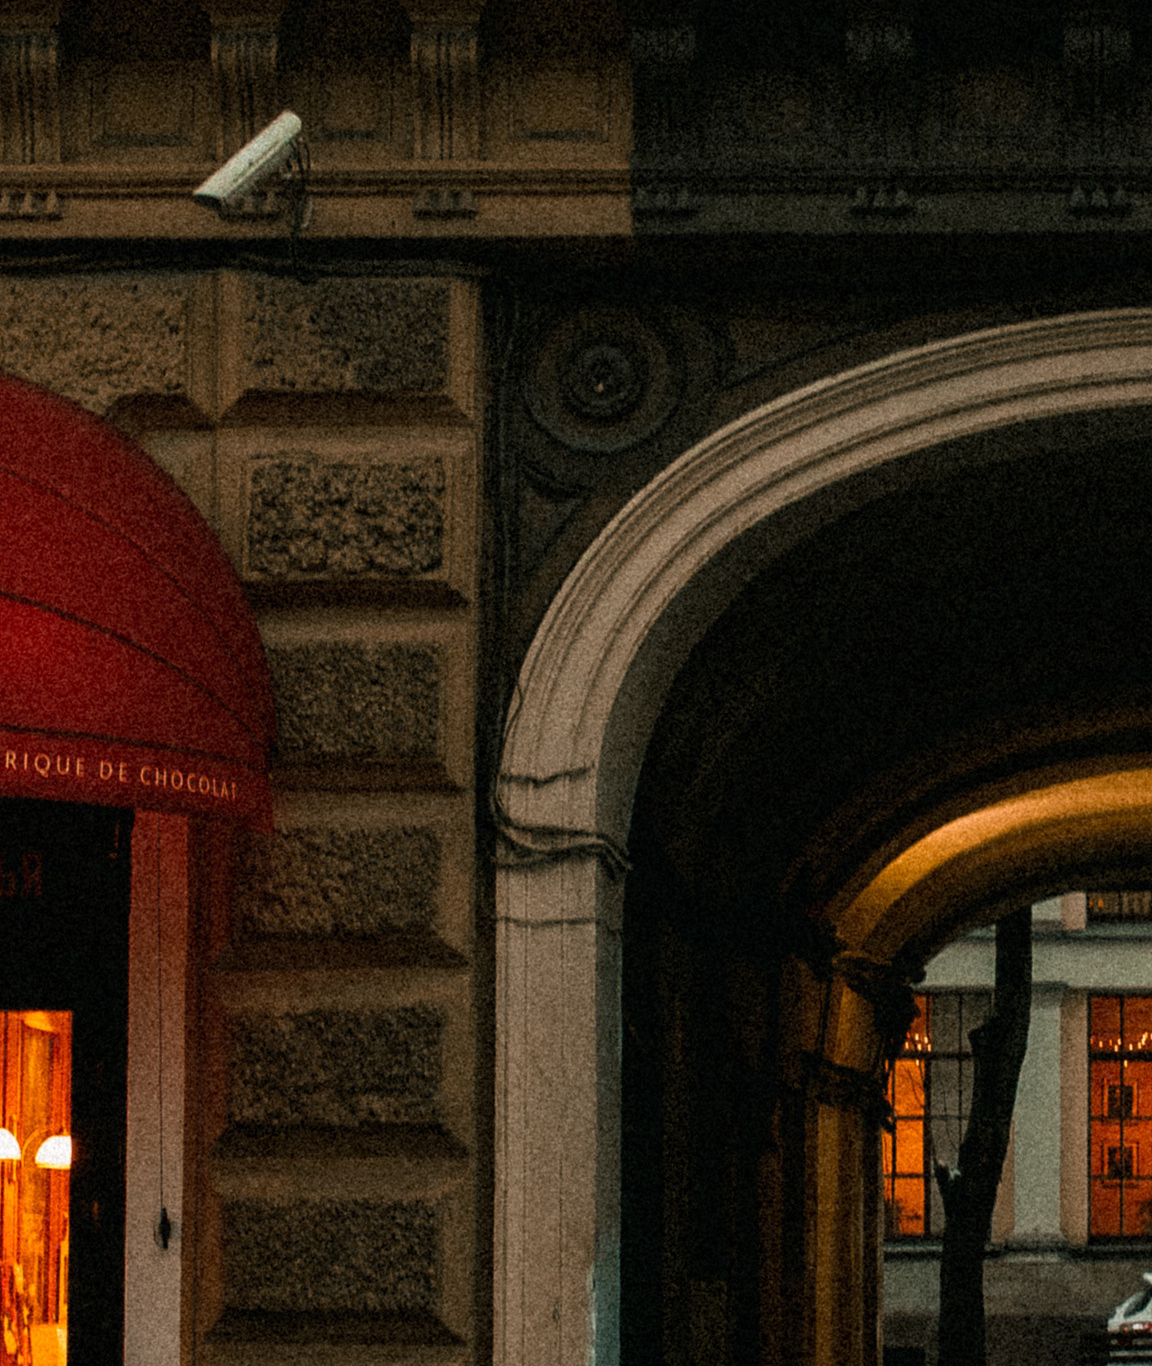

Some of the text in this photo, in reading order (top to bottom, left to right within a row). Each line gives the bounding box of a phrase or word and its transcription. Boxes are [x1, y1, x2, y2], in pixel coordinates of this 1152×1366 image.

[4, 750, 237, 801] RIQUE DE CHOCOLAT
